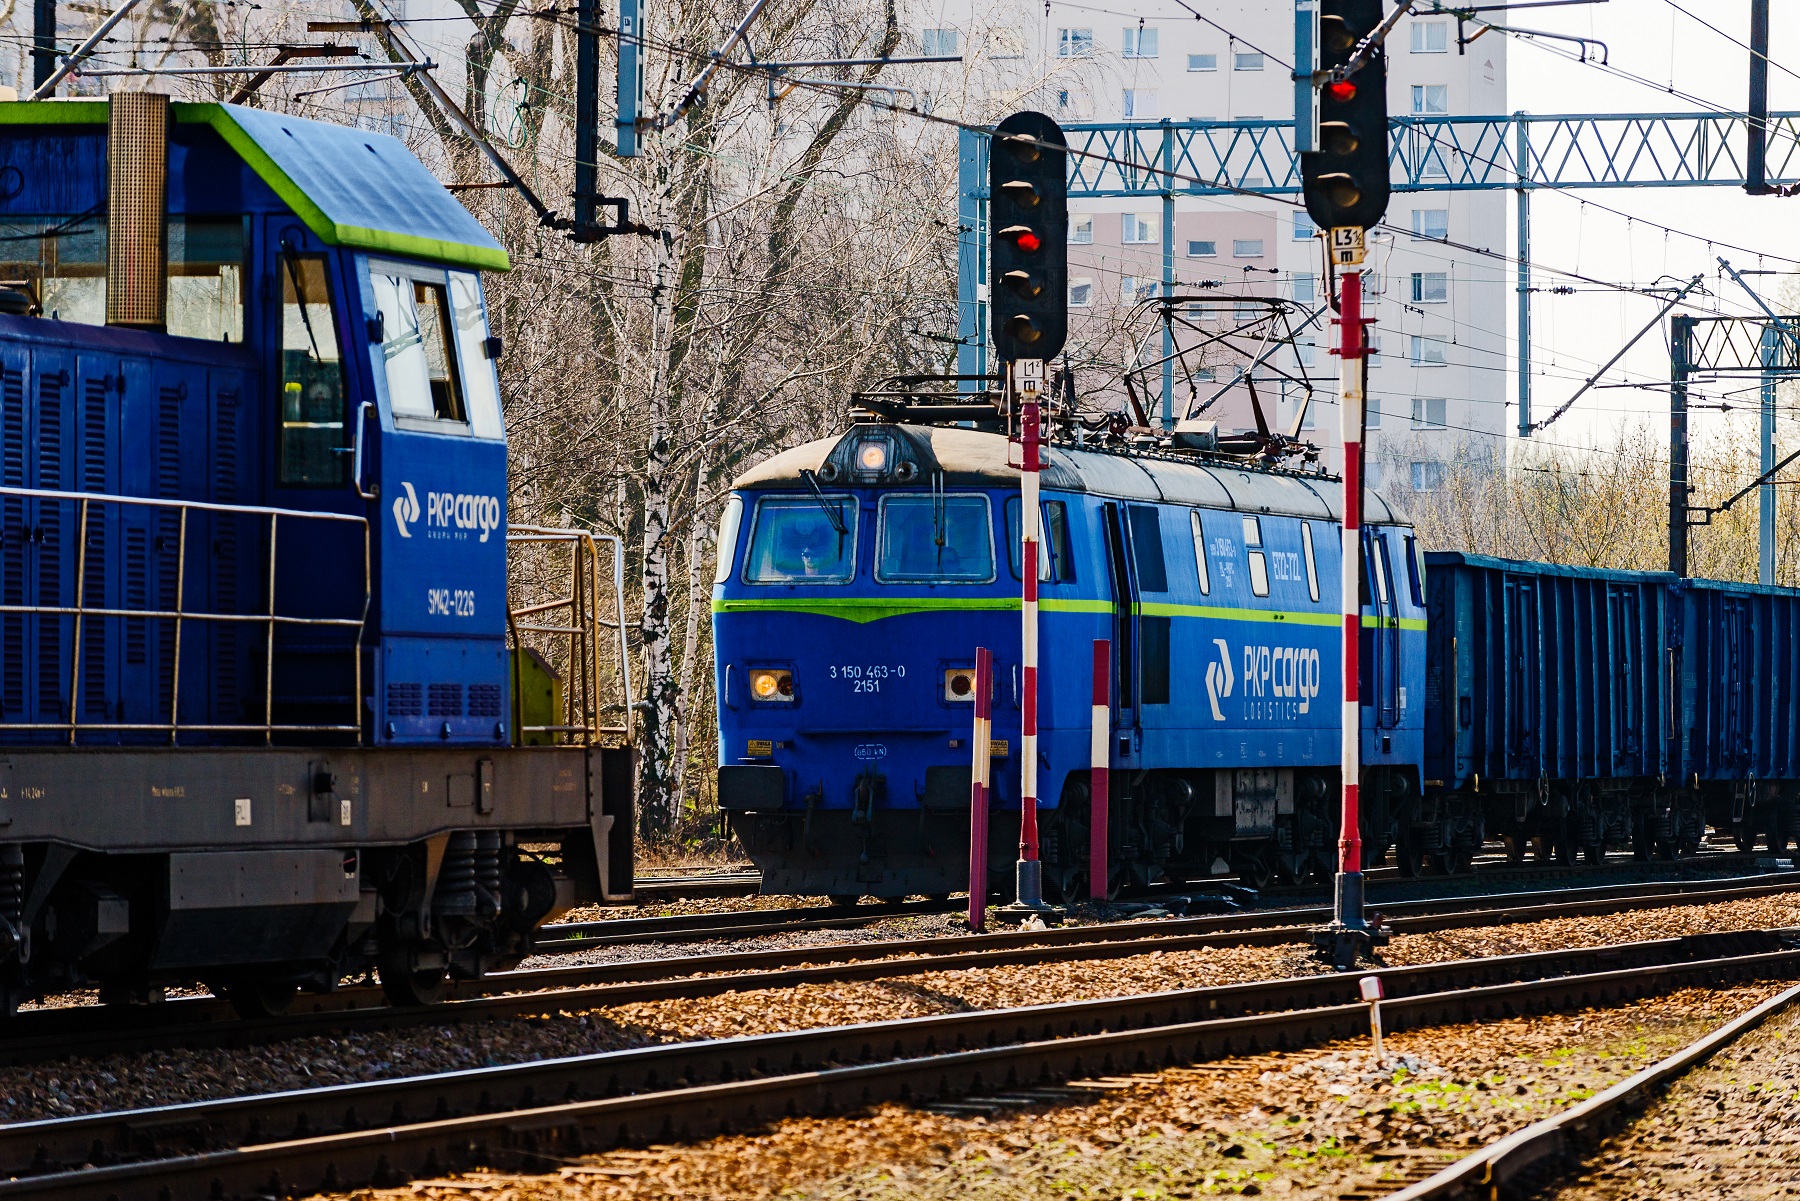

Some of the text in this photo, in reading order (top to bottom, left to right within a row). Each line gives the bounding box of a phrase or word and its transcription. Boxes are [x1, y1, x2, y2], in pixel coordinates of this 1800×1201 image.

[428, 588, 475, 616] SM42-1226
[829, 665, 837, 678] 3
[841, 665, 861, 678] 150
[853, 680, 880, 693] 2151
[1243, 701, 1297, 720] LOGISTICS
